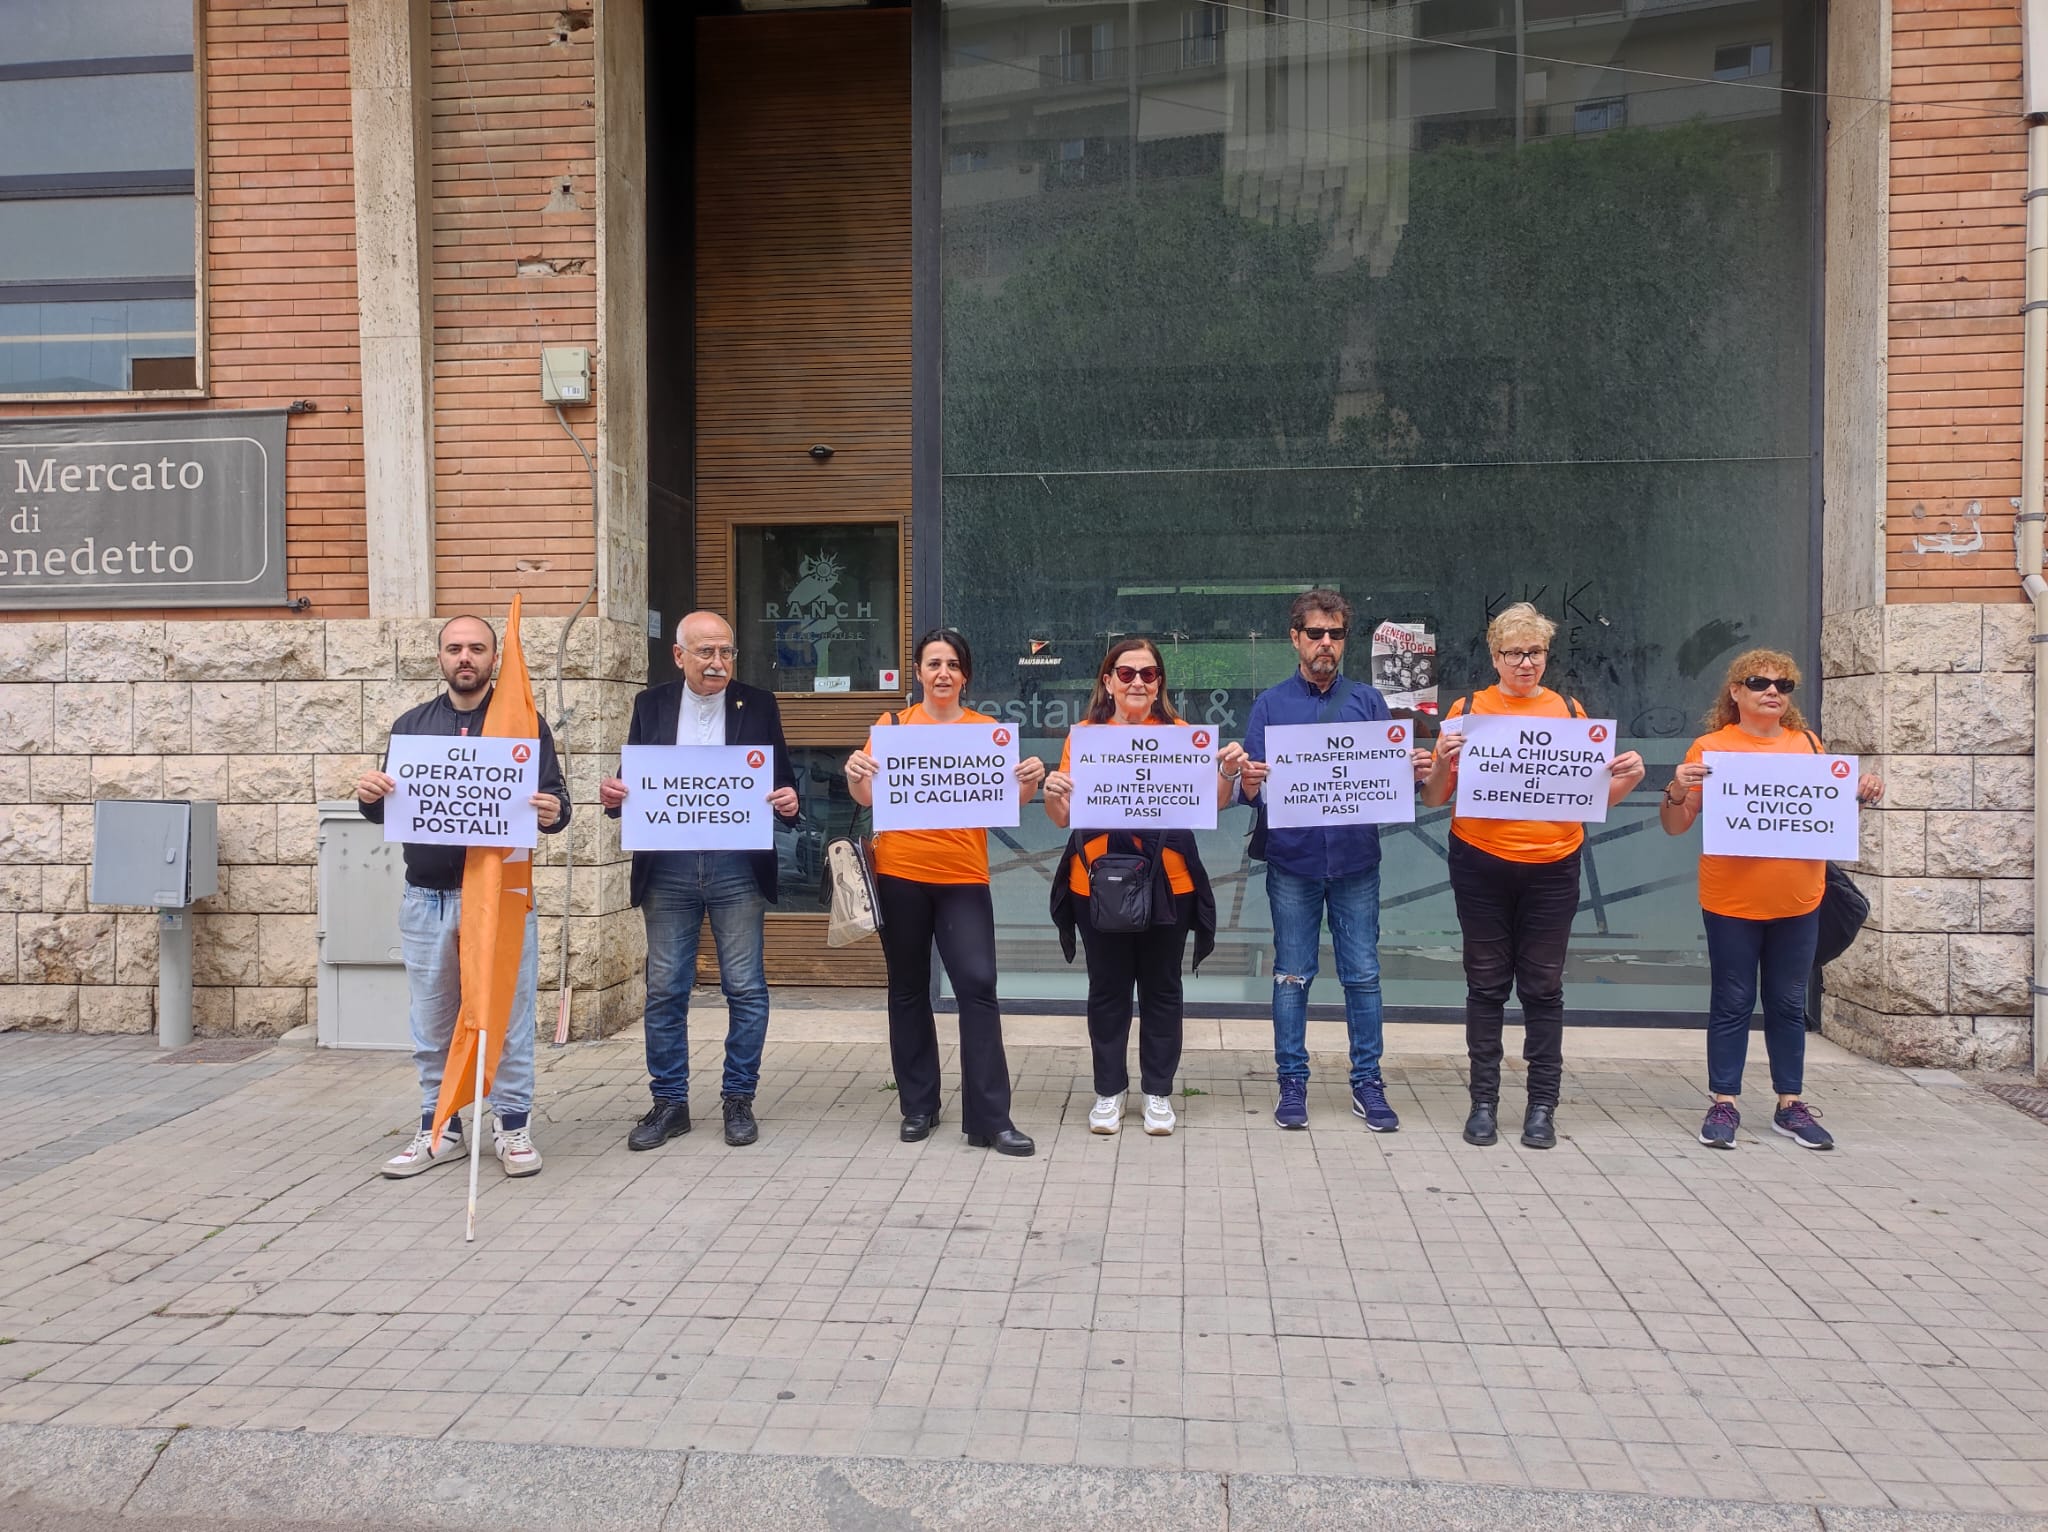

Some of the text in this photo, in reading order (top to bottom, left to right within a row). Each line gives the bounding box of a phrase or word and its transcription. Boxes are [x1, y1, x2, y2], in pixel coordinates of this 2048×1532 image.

[14, 457, 204, 494] Mercato
[10, 507, 41, 534] di
[766, 601, 872, 619] RANCH
[1205, 688, 1237, 728] &
[1132, 738, 1158, 751] NO
[1328, 736, 1354, 749] NO
[1520, 731, 1552, 746] NO
[448, 748, 476, 762] GLI
[887, 754, 1005, 770] DIFENDIAMO
[1080, 754, 1210, 764] AL TRASFERIMENTO
[1276, 749, 1406, 764] AL TRASFERIMENTO
[1469, 746, 1606, 763] ALLA CHIUSURA
[400, 764, 523, 783] OPERATORI
[1136, 768, 1151, 781] SI
[1332, 766, 1347, 778] SI
[1479, 761, 1593, 778] del MERCATO
[642, 776, 754, 790] IL MERCATO
[888, 772, 1004, 787] UN SIMBOLO
[1290, 779, 1390, 792] AD INTERVENTI
[1524, 777, 1540, 789] di
[408, 784, 512, 800] NON SONO
[1094, 784, 1193, 793] AD INTERVENTI
[1723, 783, 1839, 800] IL MERCATO
[666, 794, 730, 807] CIVICO
[890, 789, 1003, 804] DI CAGLIARI!
[1087, 795, 1200, 805] MIRATI A PICCOLI
[1284, 791, 1396, 804] MIRATI A PICCOLI
[1472, 789, 1593, 805] S.BENEDETTO!
[420, 800, 500, 817] PACCHI
[1125, 808, 1161, 817] PASSI
[1322, 805, 1358, 815] PASSI
[1747, 801, 1813, 815] CIVICO
[645, 811, 750, 824] VA DIFESO!
[1726, 817, 1834, 833] VA DIFESO!
[413, 817, 508, 835] POSTALI!
